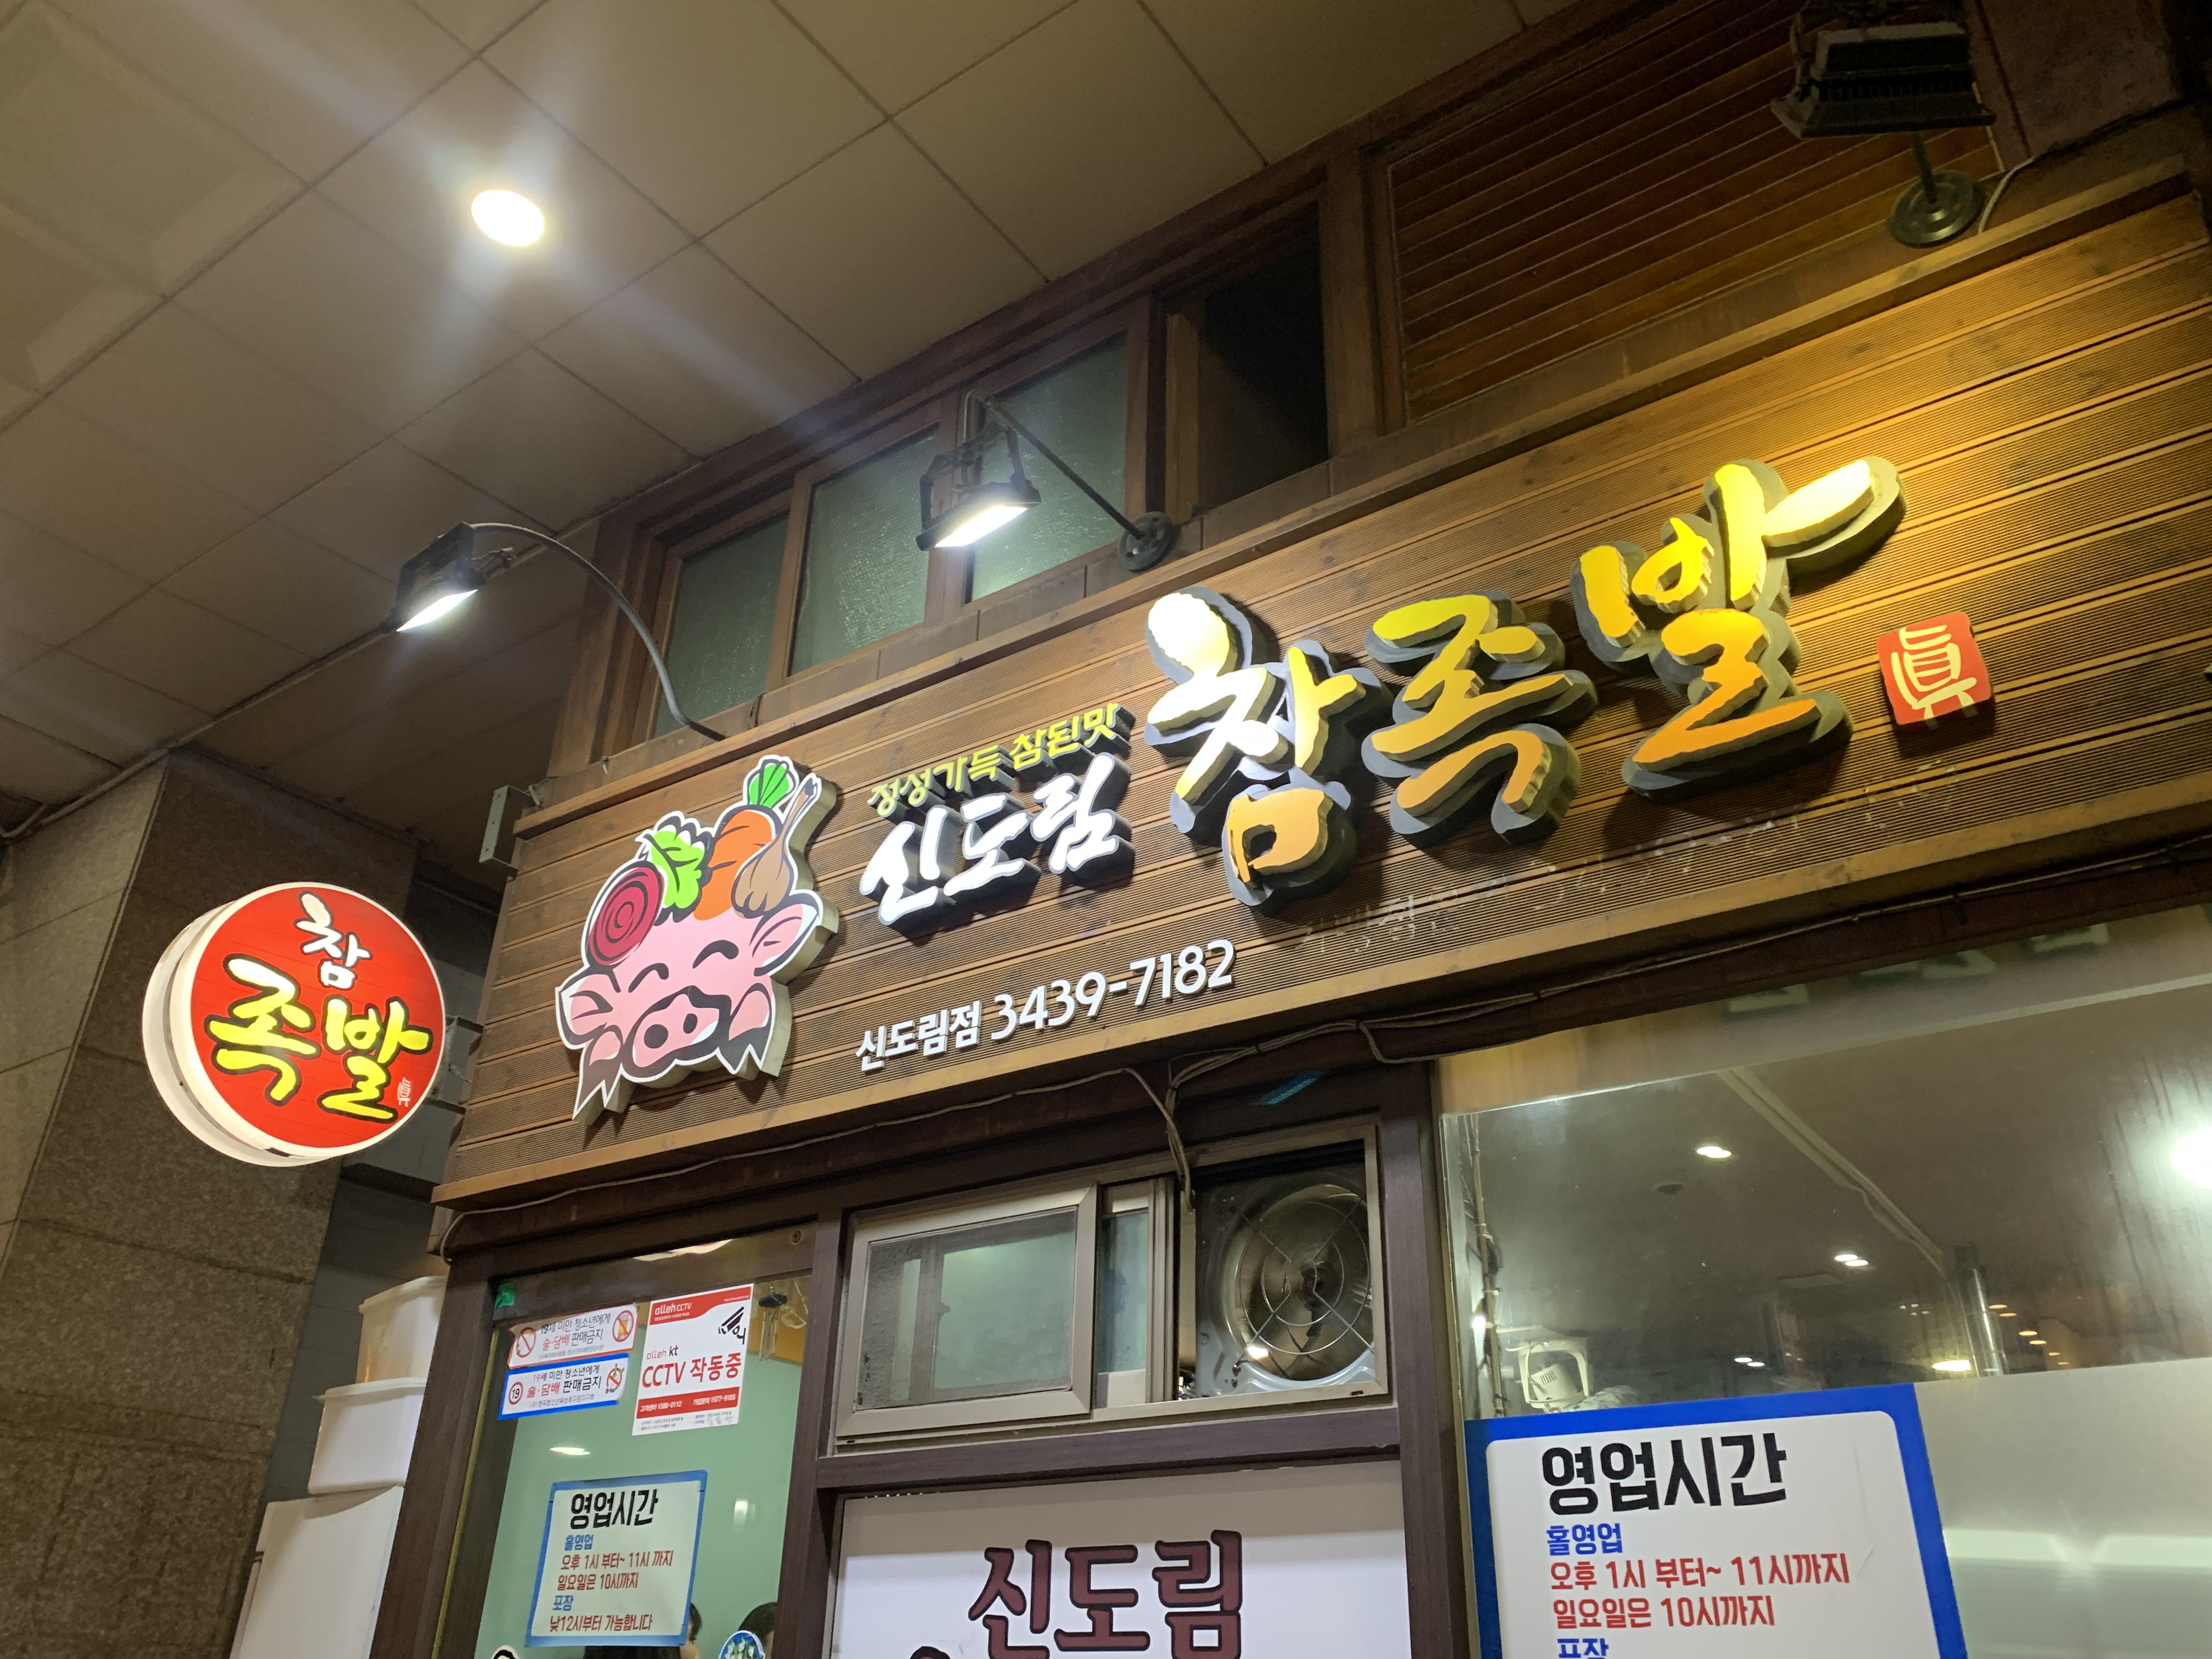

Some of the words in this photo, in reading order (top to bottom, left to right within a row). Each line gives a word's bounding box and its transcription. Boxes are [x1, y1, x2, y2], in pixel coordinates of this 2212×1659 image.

[859, 752, 1120, 926] 신도림
[1144, 455, 1905, 912] 참족발
[868, 755, 1001, 818] 정성가득
[1010, 702, 1120, 771] 참된맛
[294, 890, 373, 990] 참
[856, 1001, 983, 1072] 신도림점
[991, 939, 1239, 1041] 3439-7182
[204, 953, 433, 1125] 족발
[540, 1323, 556, 1335] 19세
[557, 1320, 573, 1333] 미만
[573, 1313, 611, 1331] 청소년에게
[571, 1328, 603, 1346] 판매금지
[646, 1349, 667, 1360] olleh
[668, 1345, 679, 1357] kt
[533, 1373, 547, 1383] 19세
[549, 1370, 563, 1380] 미만
[565, 1365, 600, 1379] 청소년에게
[562, 1376, 602, 1393] 판매금지
[642, 1361, 686, 1388] CCTV
[690, 1352, 742, 1383] 작동중
[511, 1388, 520, 1400] 19
[1542, 1432, 1787, 1516] 영업시간
[570, 1488, 659, 1530] 영업시간
[565, 1534, 594, 1551] 홀영업
[1546, 1522, 1624, 1556] 홀영업
[560, 1554, 581, 1570] 오후
[584, 1553, 600, 1569] 1시
[629, 1551, 650, 1567] 11시
[652, 1550, 674, 1566] 까지
[1550, 1561, 1597, 1590] 오후
[1605, 1559, 1646, 1589] 1시
[1731, 1553, 1850, 1587] 11시까지
[557, 1573, 596, 1591] 일요일은
[600, 1572, 640, 1590] 10시까지
[968, 1529, 1244, 1659] 신도림
[552, 1594, 574, 1611] 포장
[1553, 1598, 1652, 1629] 일요일은
[1660, 1595, 1776, 1628] 10시까지
[550, 1614, 603, 1633] 낮12시부터
[605, 1614, 653, 1631] 가능합니다
